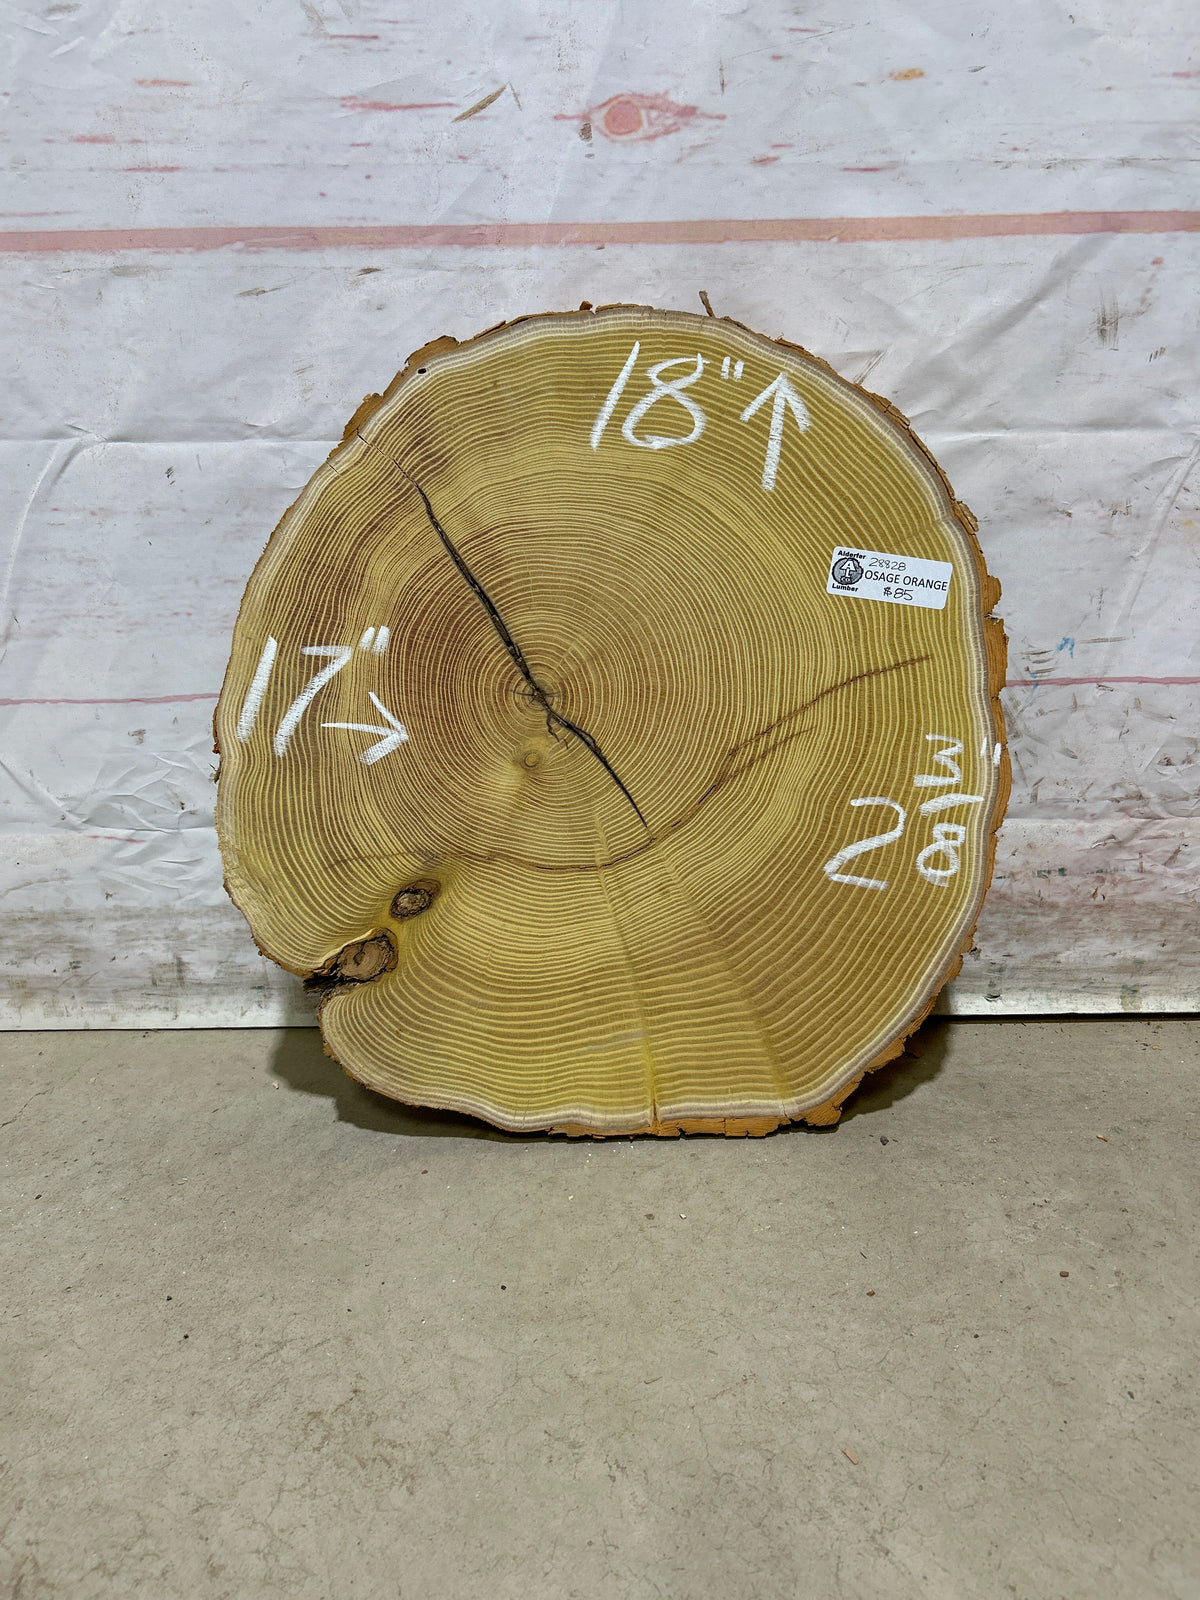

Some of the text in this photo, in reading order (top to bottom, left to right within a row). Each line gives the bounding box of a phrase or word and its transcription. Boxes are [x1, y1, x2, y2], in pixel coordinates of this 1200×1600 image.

[589, 340, 746, 452] 18"
[837, 550, 867, 560] Alderfer
[831, 582, 859, 592] Lumber
[864, 569, 948, 592] OSAGE ORANGE
[236, 625, 390, 758] 17"
